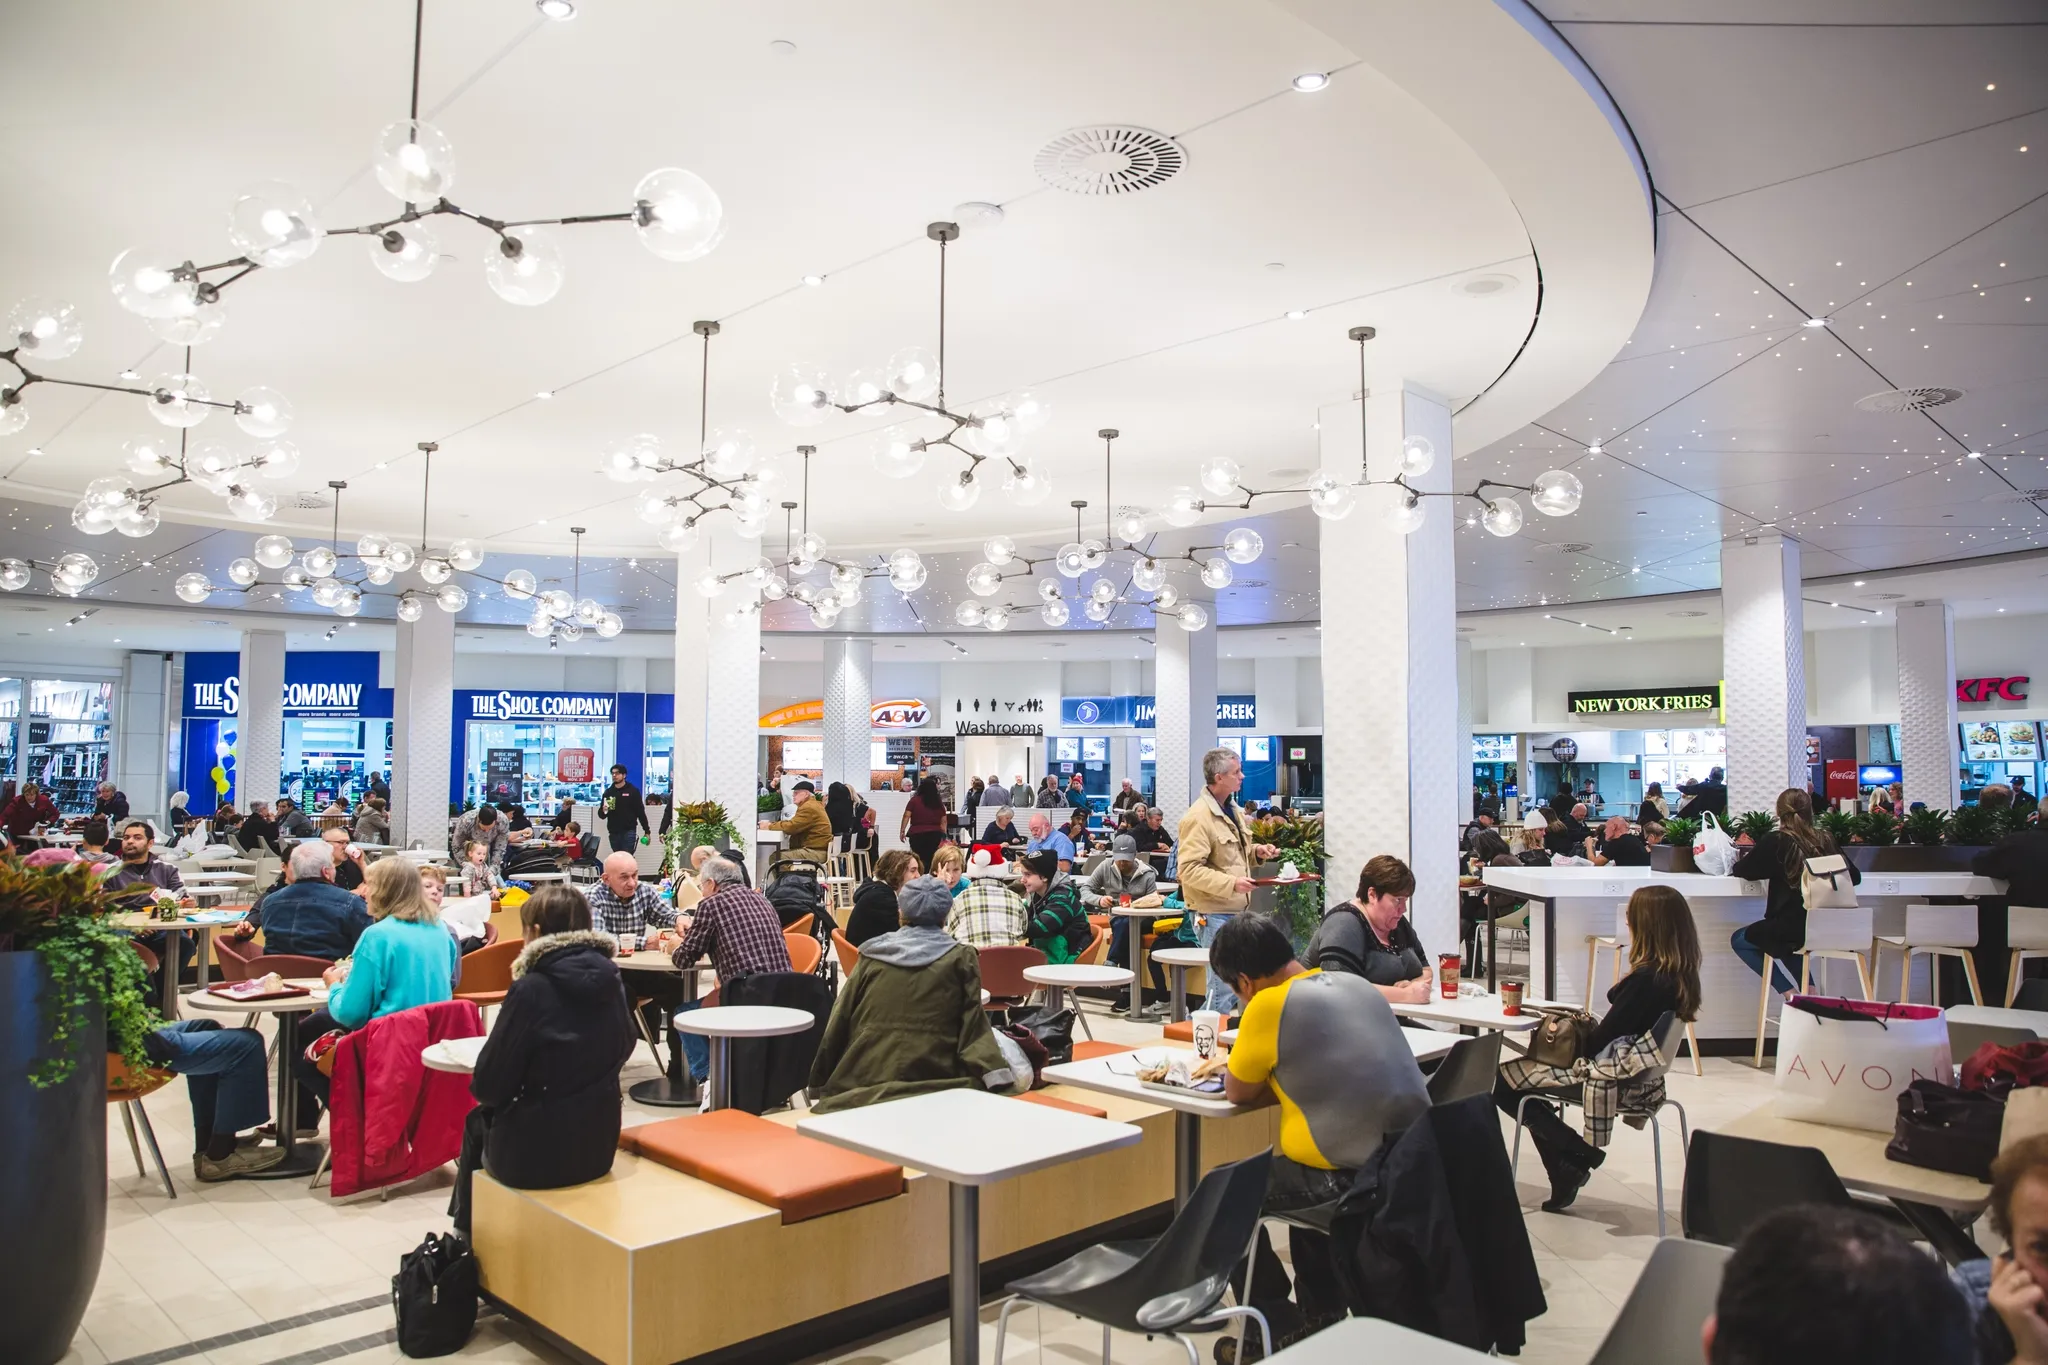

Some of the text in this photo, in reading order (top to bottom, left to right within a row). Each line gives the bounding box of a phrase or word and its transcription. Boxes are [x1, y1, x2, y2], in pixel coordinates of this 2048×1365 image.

[193, 683, 223, 705] THE
[1956, 676, 2030, 702] KFC
[471, 691, 613, 720] THE SHOE COMPANY
[1216, 703, 1255, 720] GREEK
[1575, 694, 1713, 713] NEW YORK FRIES
[875, 710, 927, 723] A&W
[956, 720, 1043, 735] Washrooms
[888, 738, 912, 746] WE'RE
[563, 755, 588, 765] RALPH
